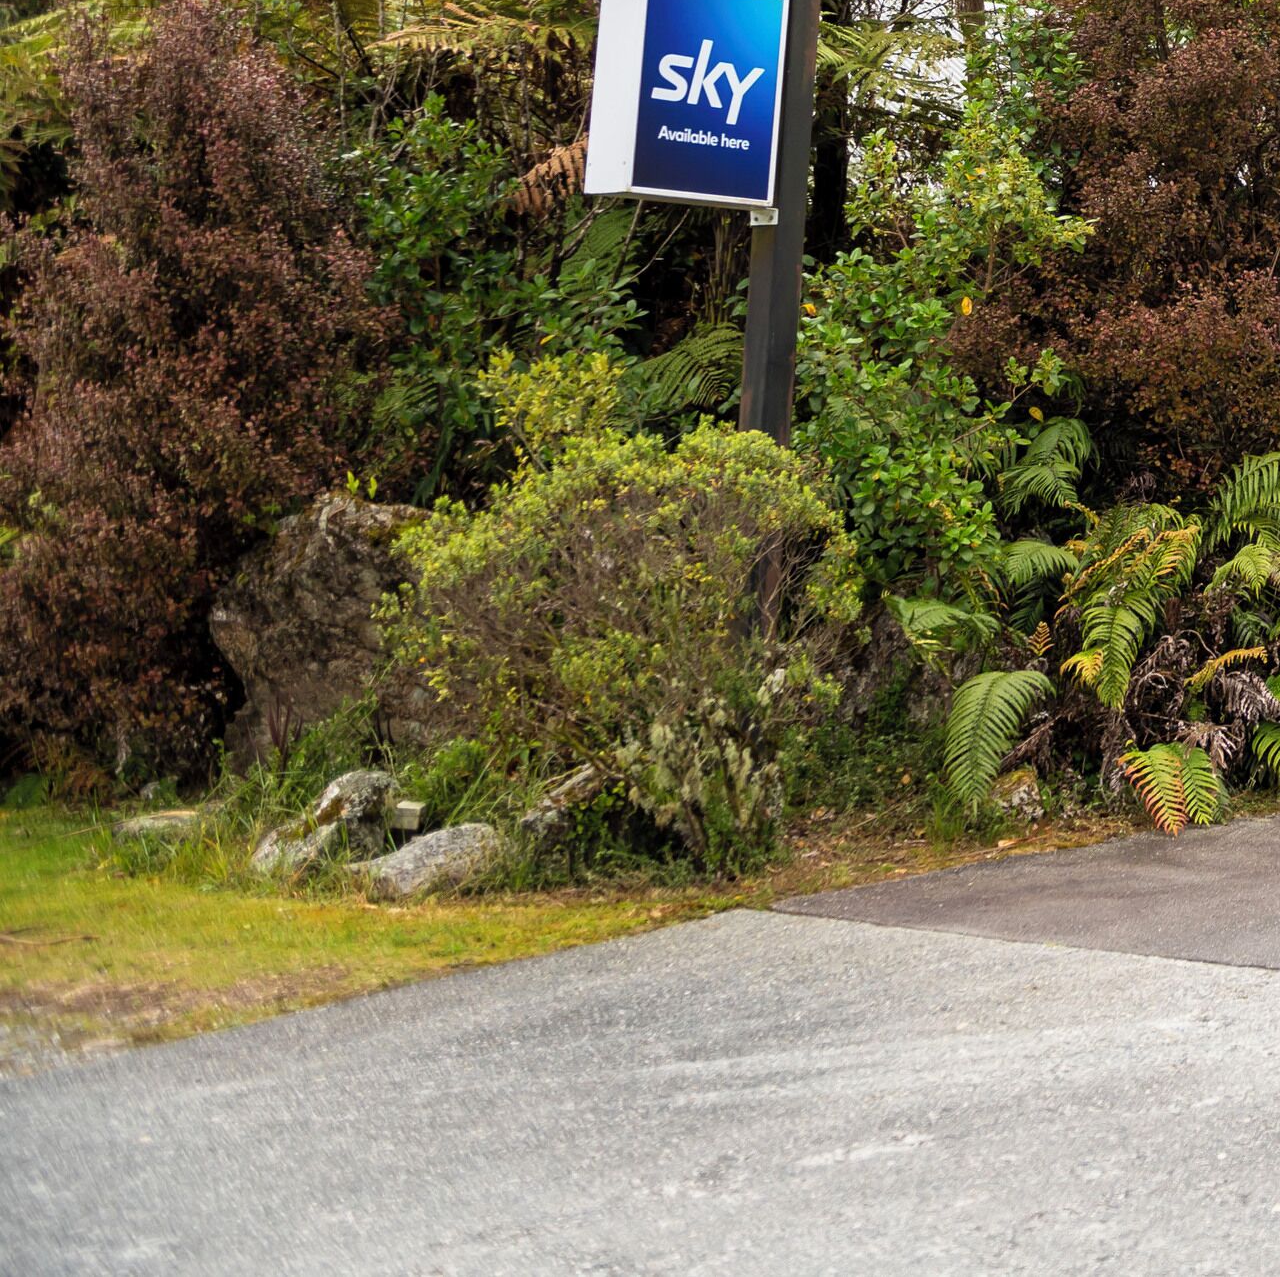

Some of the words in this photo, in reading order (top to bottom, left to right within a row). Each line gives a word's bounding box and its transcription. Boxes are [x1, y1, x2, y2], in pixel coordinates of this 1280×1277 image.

[651, 39, 765, 126] sky
[657, 125, 718, 147] Available
[720, 134, 750, 151] here
